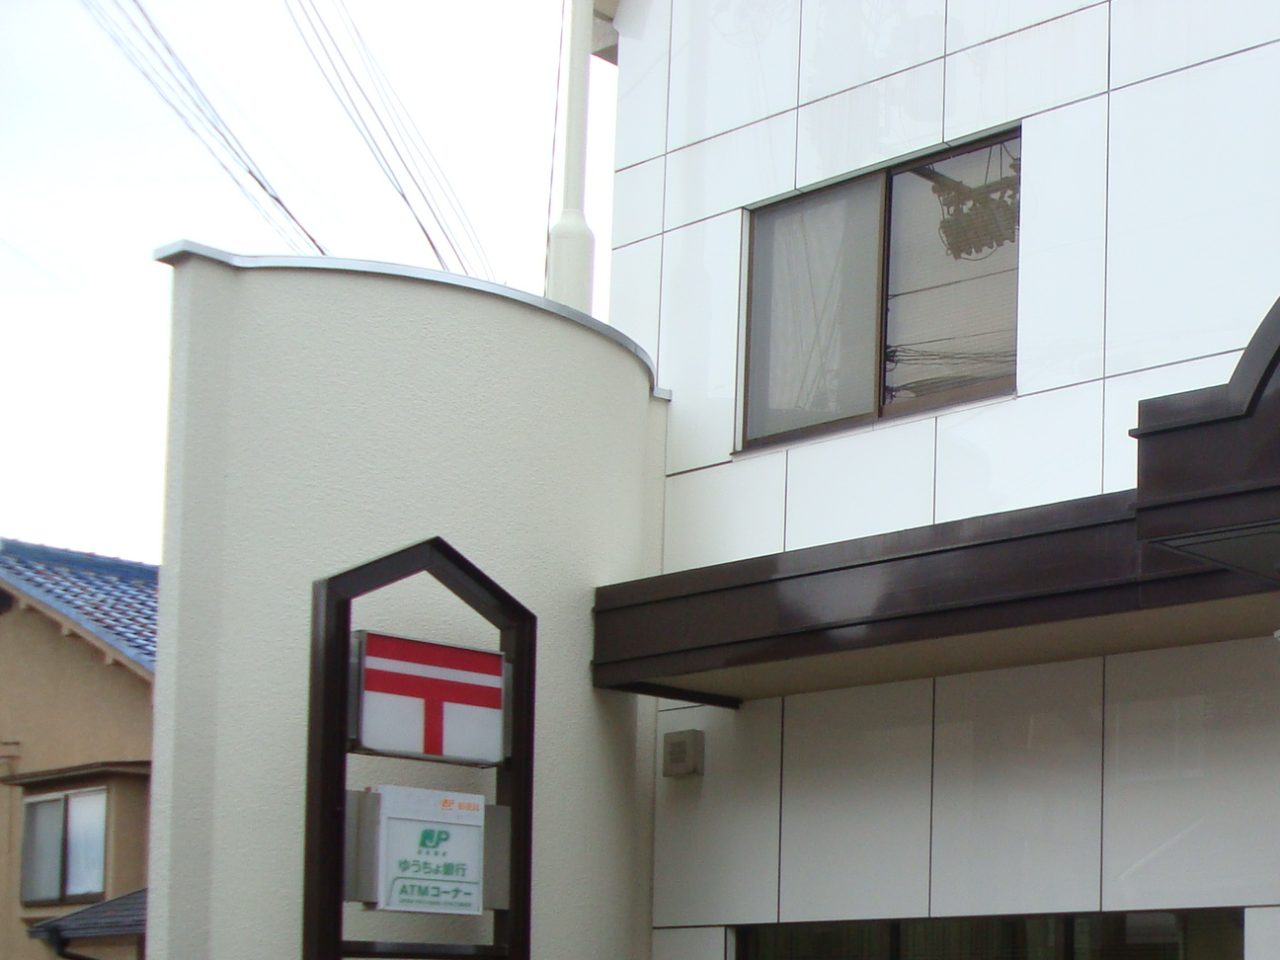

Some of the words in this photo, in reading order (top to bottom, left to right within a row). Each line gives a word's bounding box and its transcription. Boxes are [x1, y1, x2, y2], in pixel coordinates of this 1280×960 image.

[398, 859, 467, 878] ゆうちょ銀行
[399, 884, 474, 899] ATMコーナー
